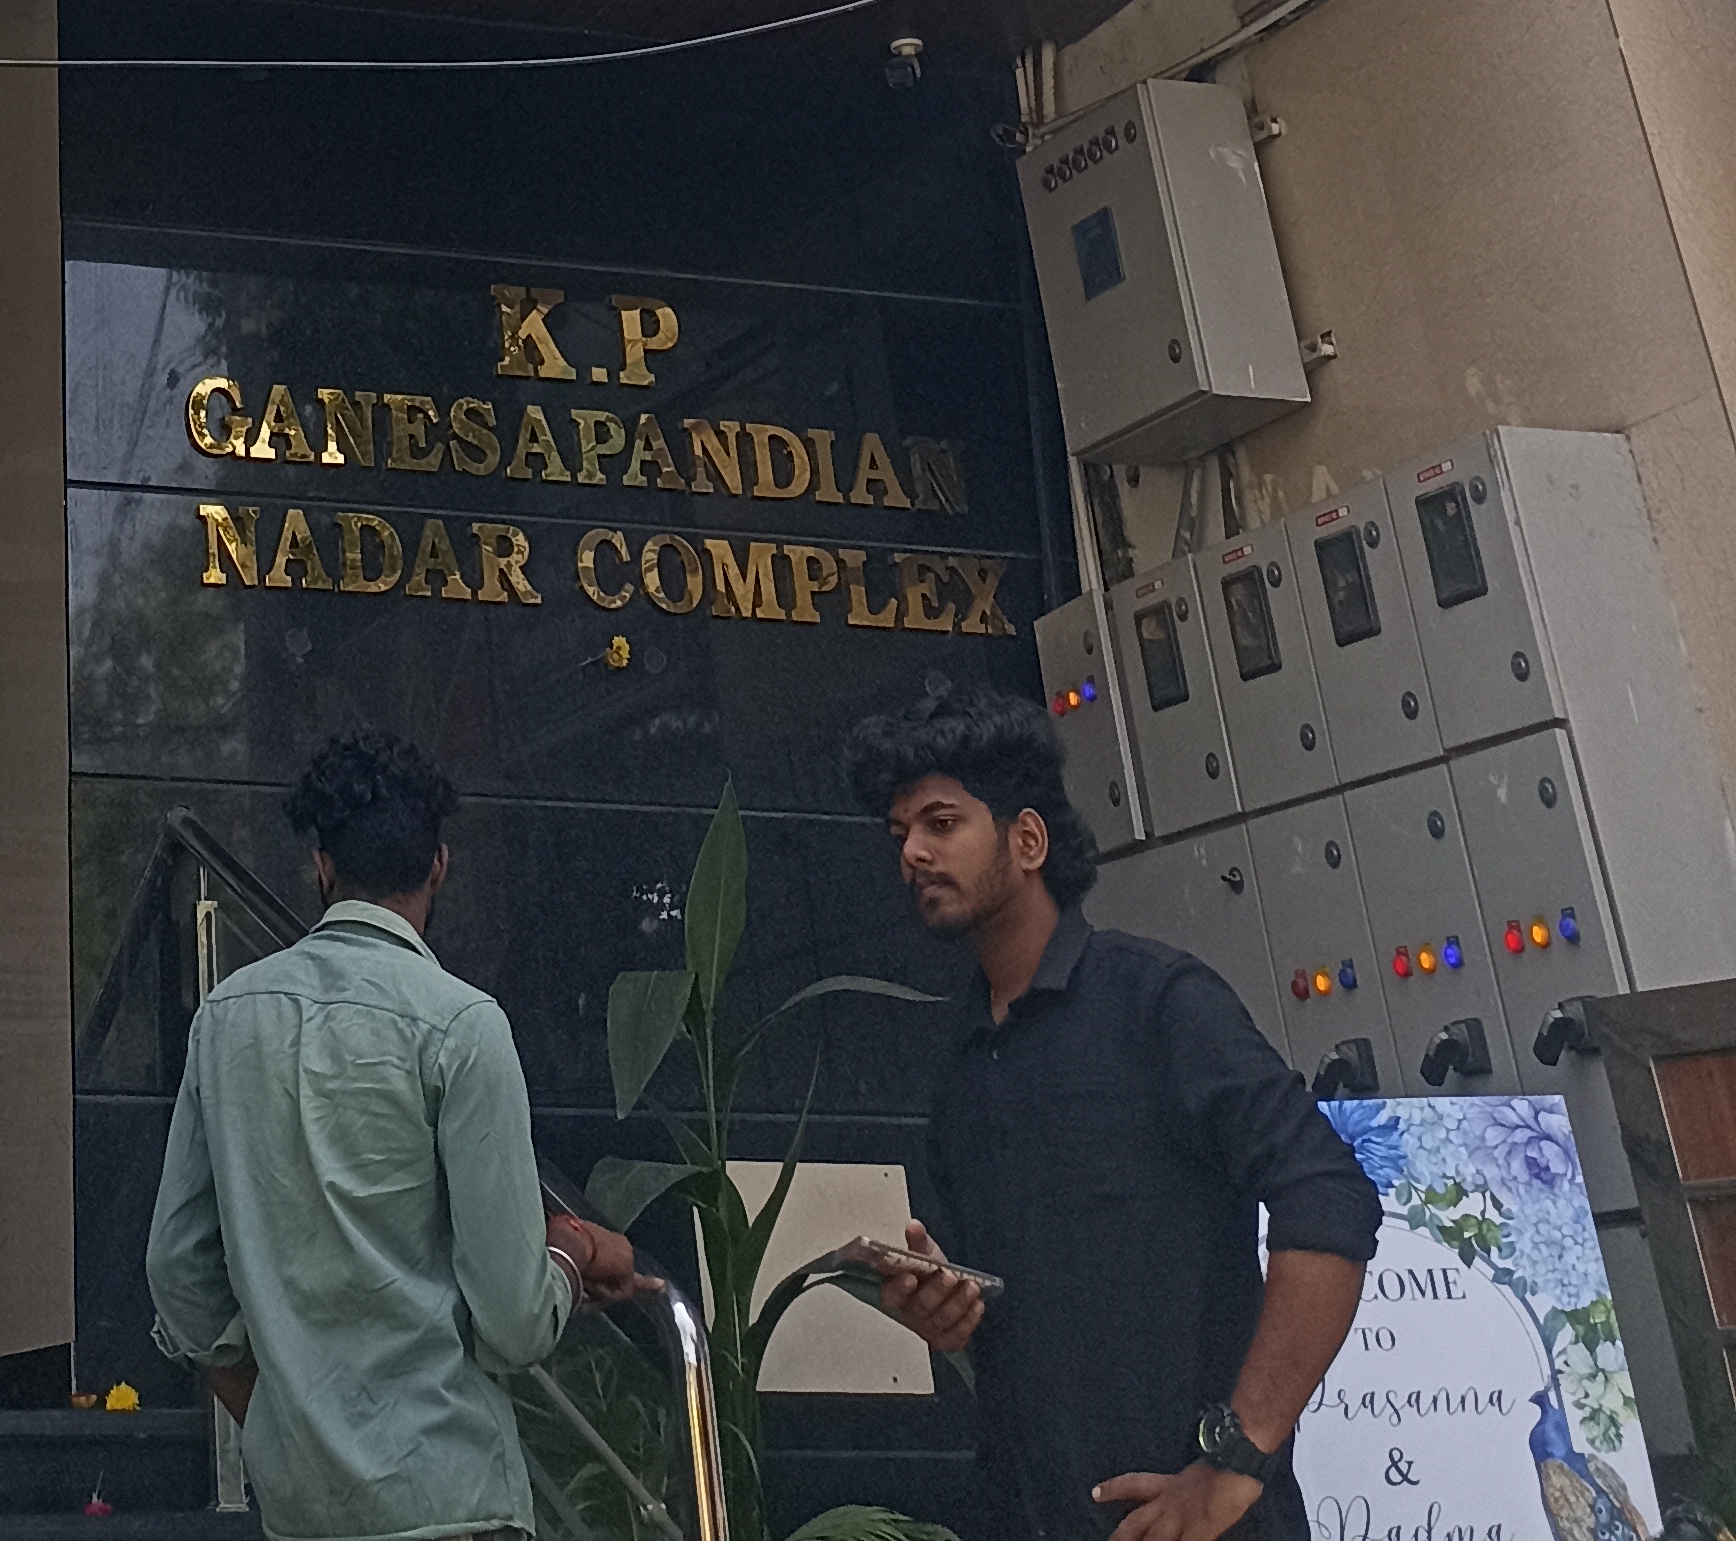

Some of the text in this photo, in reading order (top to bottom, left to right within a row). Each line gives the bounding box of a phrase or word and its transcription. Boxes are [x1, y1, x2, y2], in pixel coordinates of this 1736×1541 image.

[488, 283, 680, 388] K.P
[186, 374, 970, 515] GANESAPANDIAN
[197, 501, 1018, 636] NADAR COMPLEX
[1360, 1267, 1467, 1302] COME
[1354, 1326, 1396, 1352] TO
[1384, 1446, 1420, 1486] &
